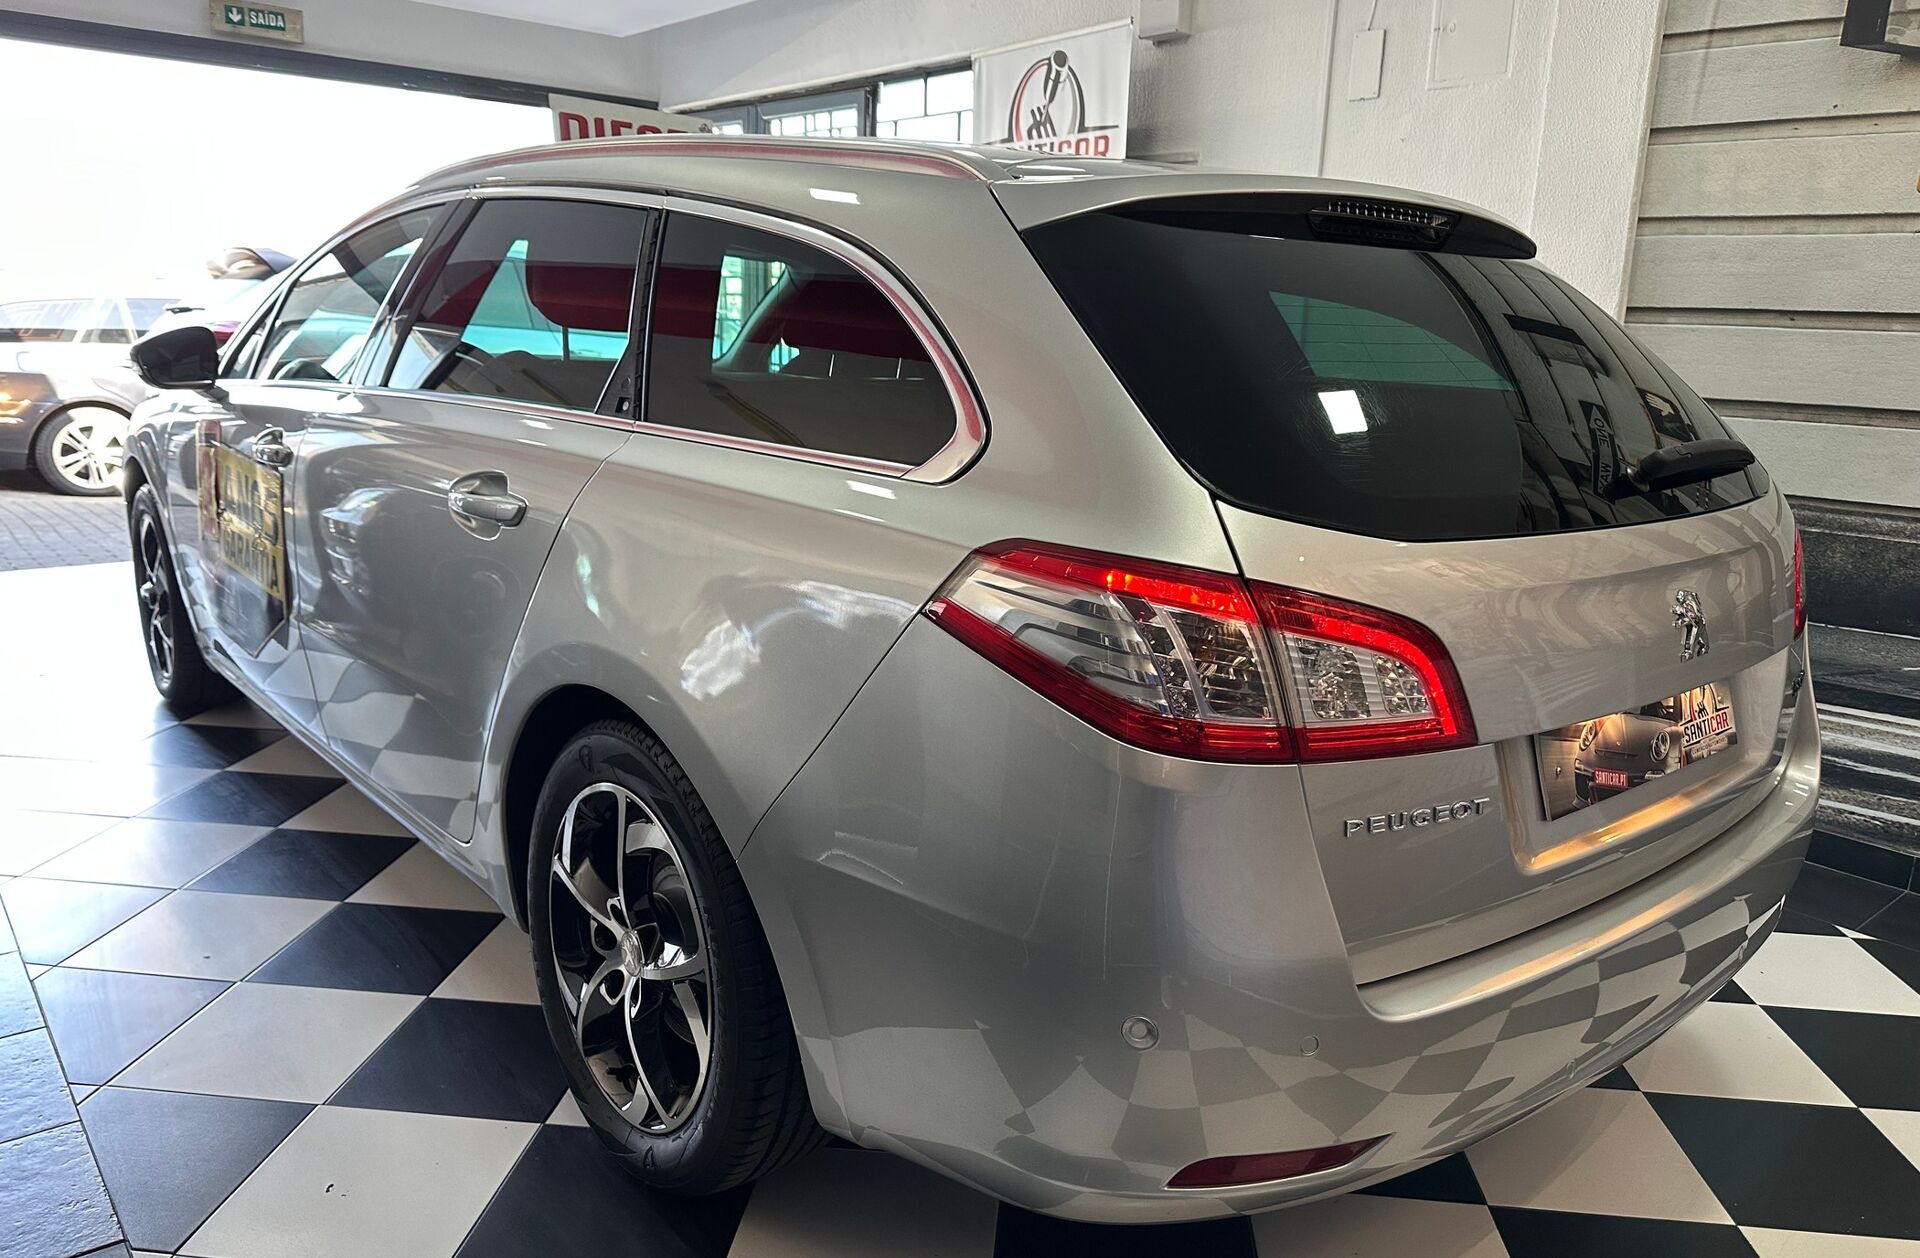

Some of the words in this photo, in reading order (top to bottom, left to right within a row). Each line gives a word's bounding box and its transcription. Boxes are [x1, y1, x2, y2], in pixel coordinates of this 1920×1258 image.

[250, 11, 284, 28] SAÍDA
[1683, 711, 1729, 743] SANTICAR
[1595, 770, 1626, 786] SANTICAR.PT
[1344, 797, 1490, 838] PEUGEOT
